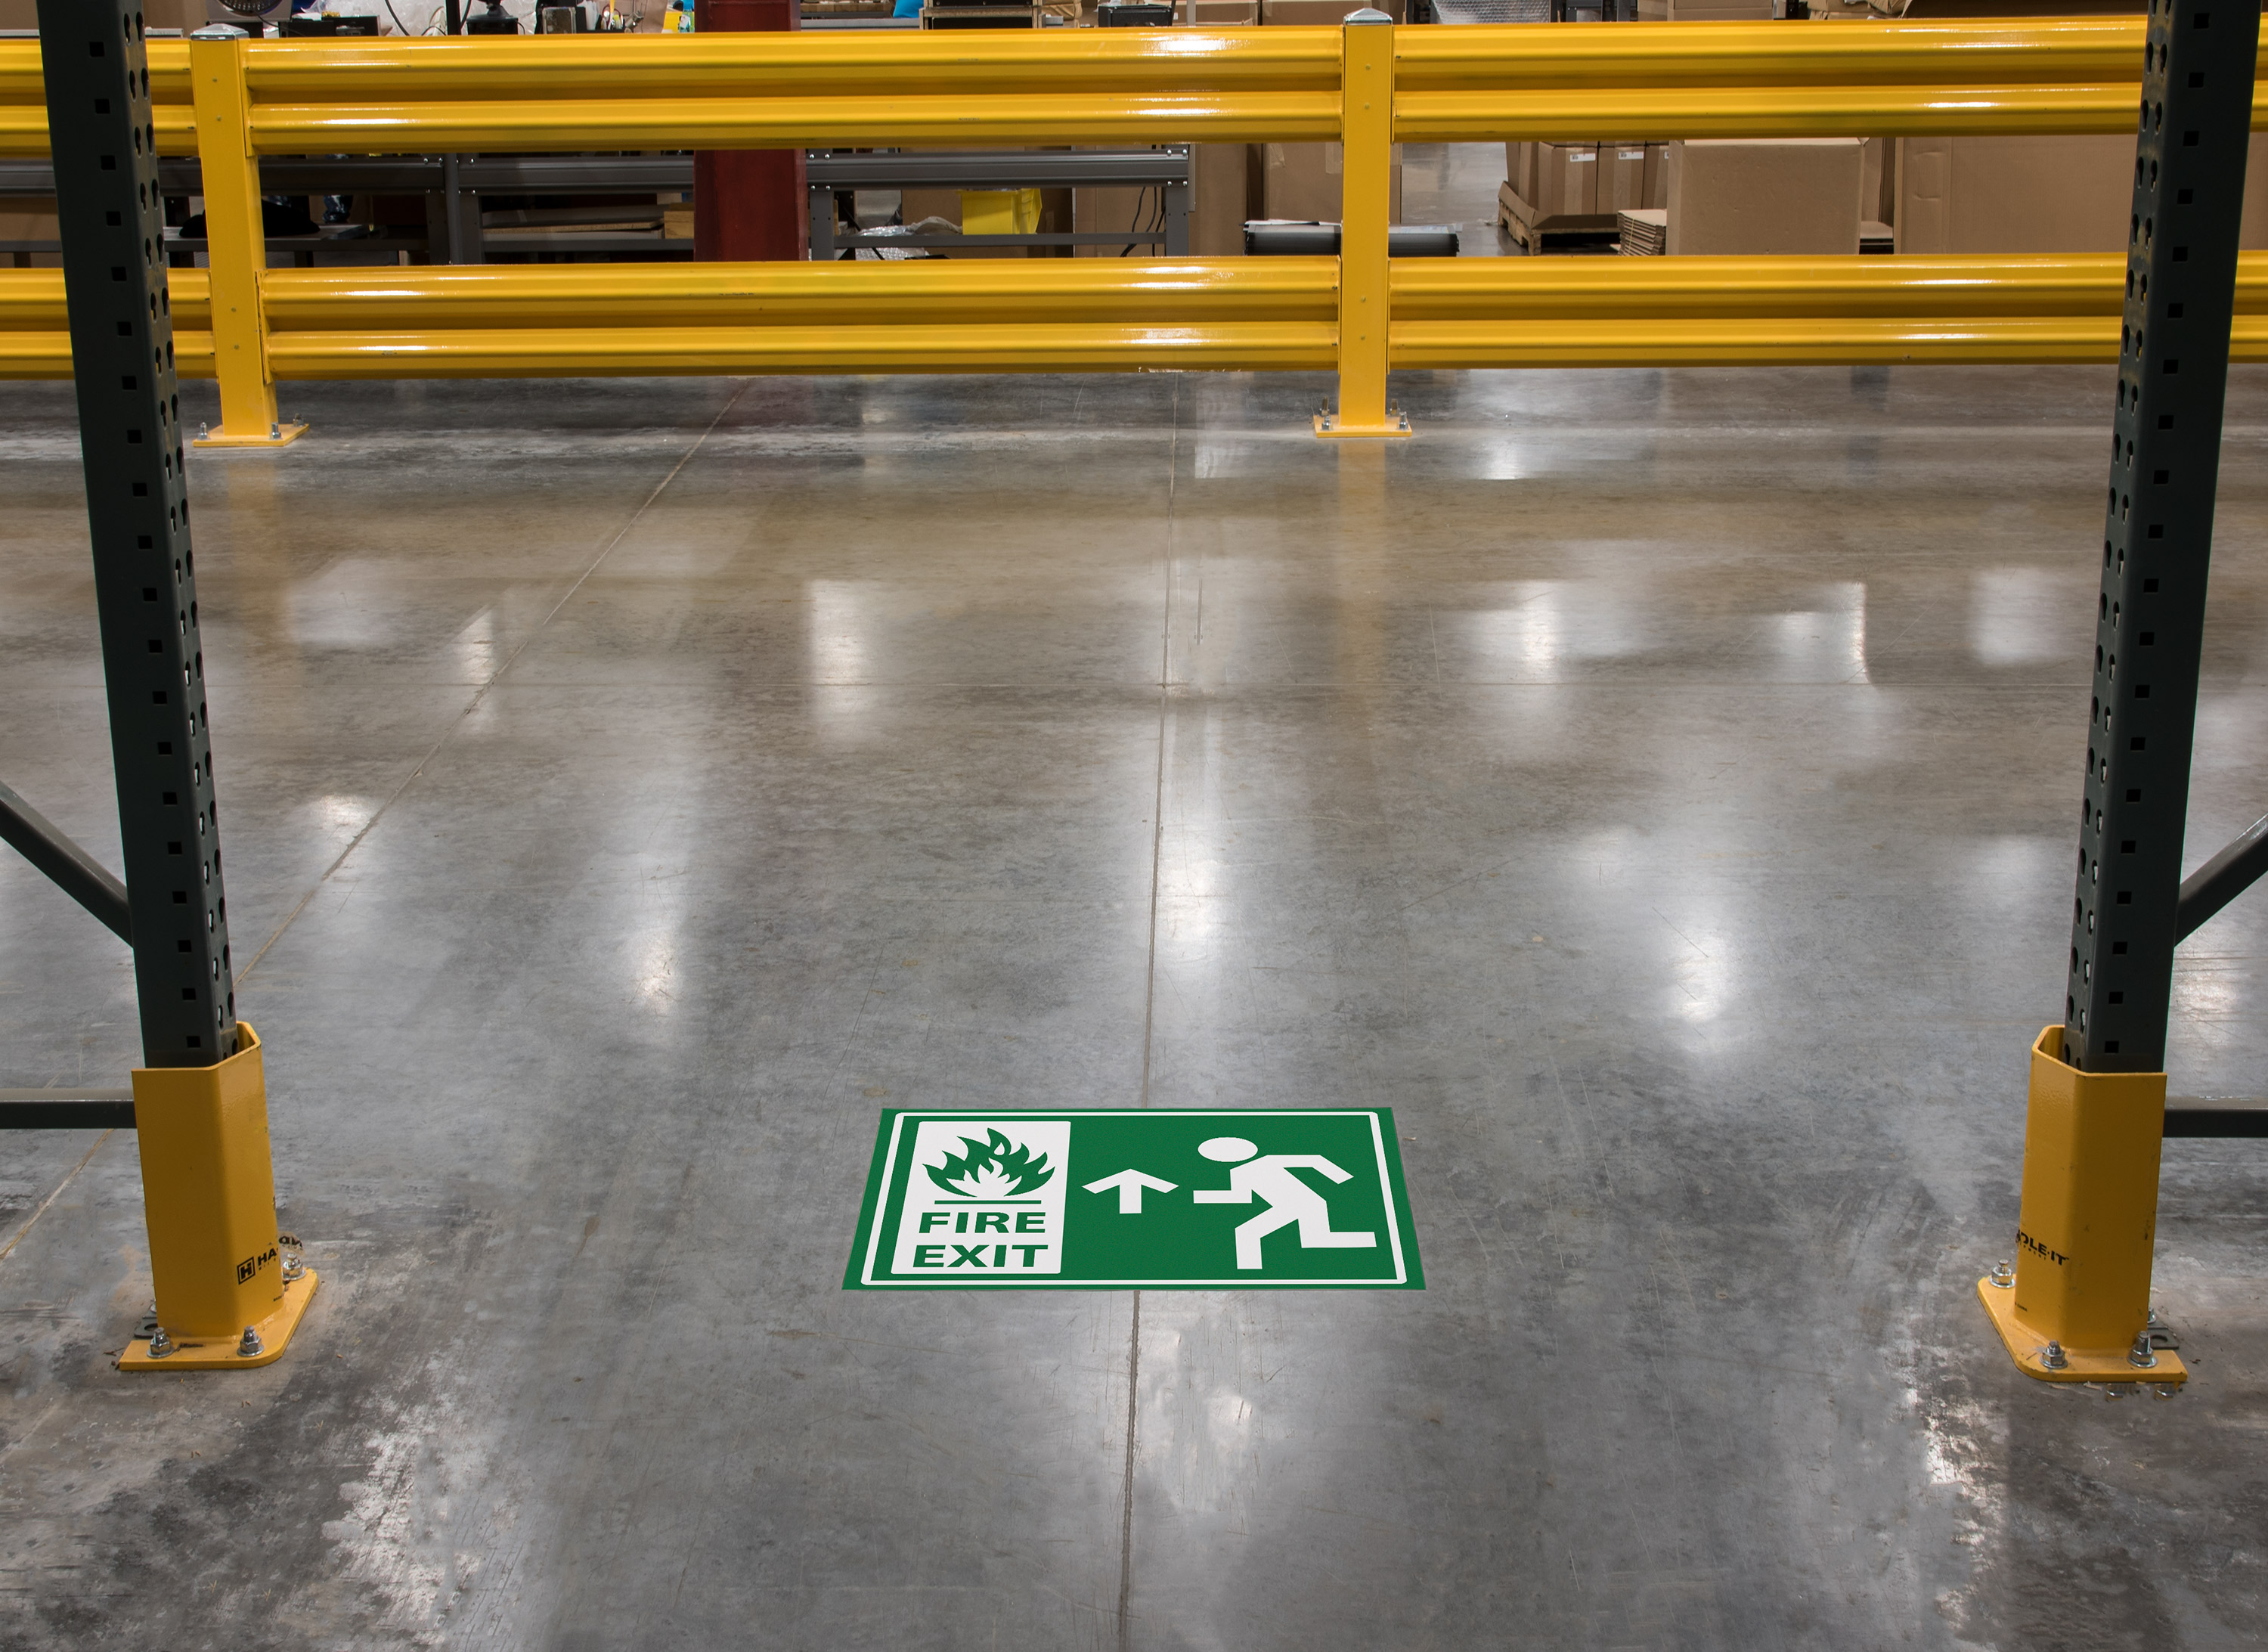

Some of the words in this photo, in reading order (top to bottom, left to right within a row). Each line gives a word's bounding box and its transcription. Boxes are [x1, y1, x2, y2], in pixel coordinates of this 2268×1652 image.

[919, 1212, 1046, 1234] FIRE
[258, 1248, 278, 1266] HA
[912, 1244, 1049, 1268] EXIT
